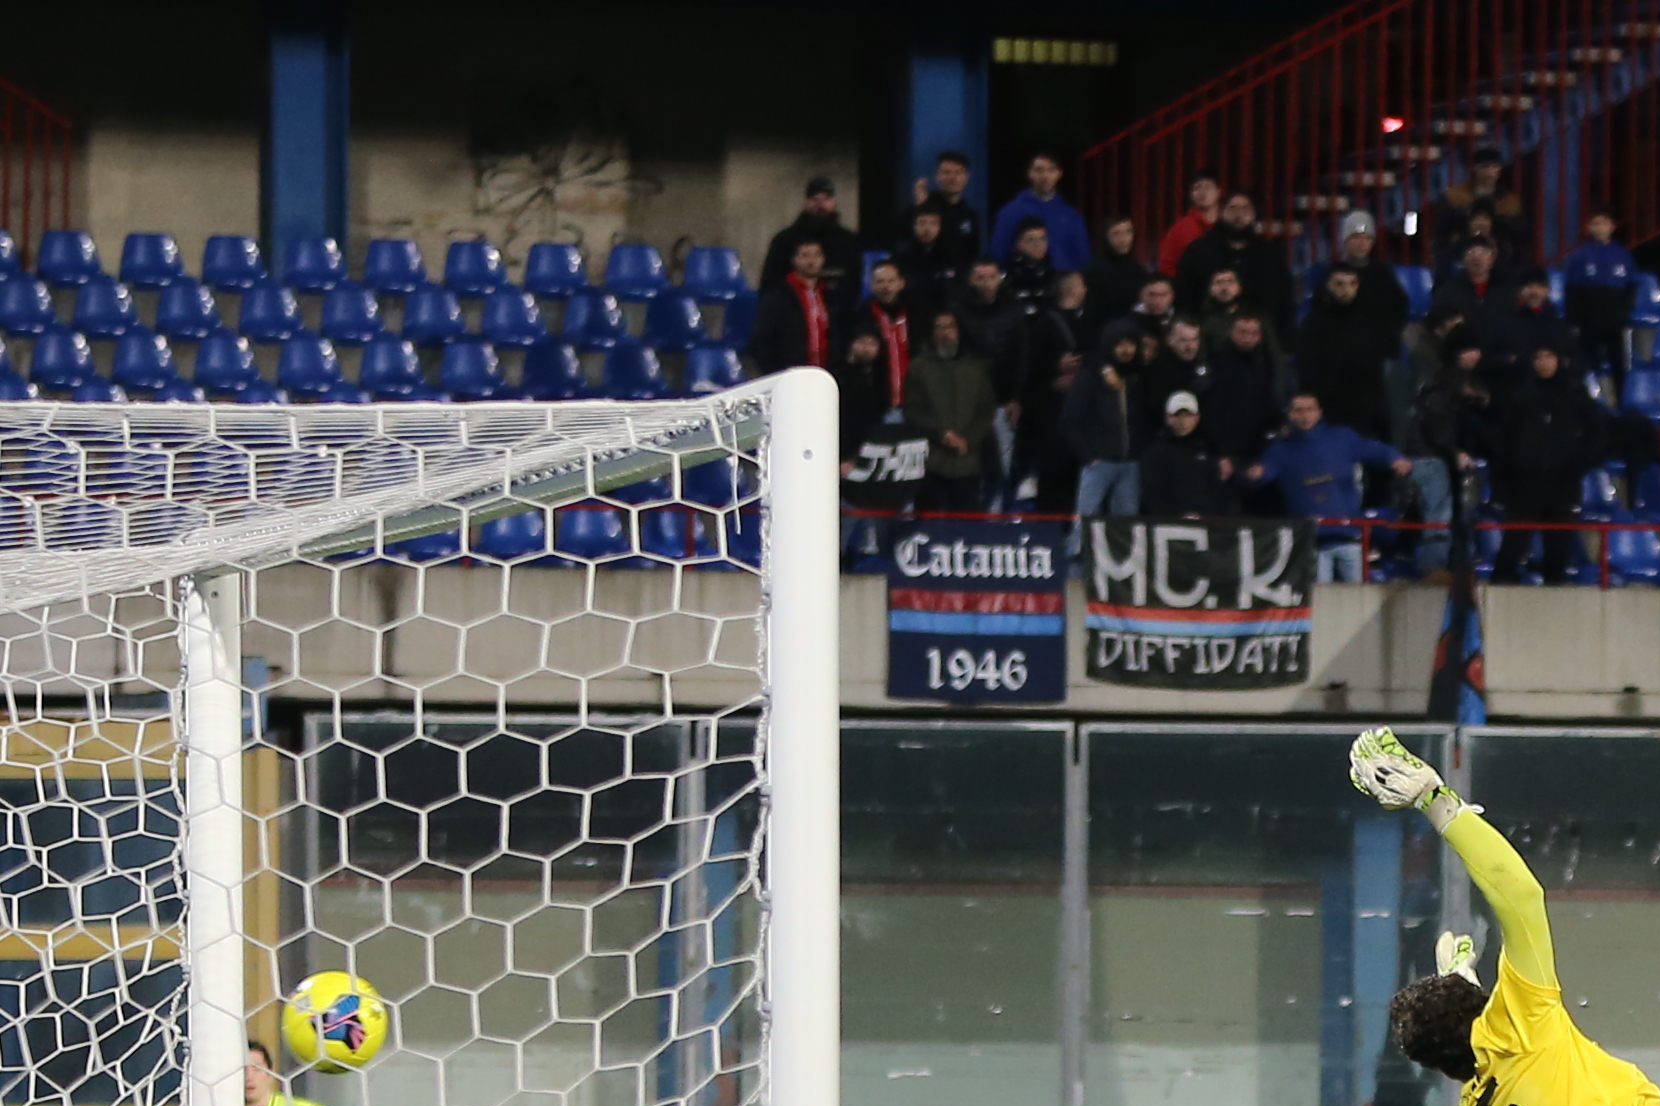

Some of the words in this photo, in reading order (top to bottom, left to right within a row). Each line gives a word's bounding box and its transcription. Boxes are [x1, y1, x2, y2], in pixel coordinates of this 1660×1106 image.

[894, 531, 1055, 580] Catania
[926, 646, 1028, 692] 1946
[1096, 631, 1302, 674] DIFFIDATI
